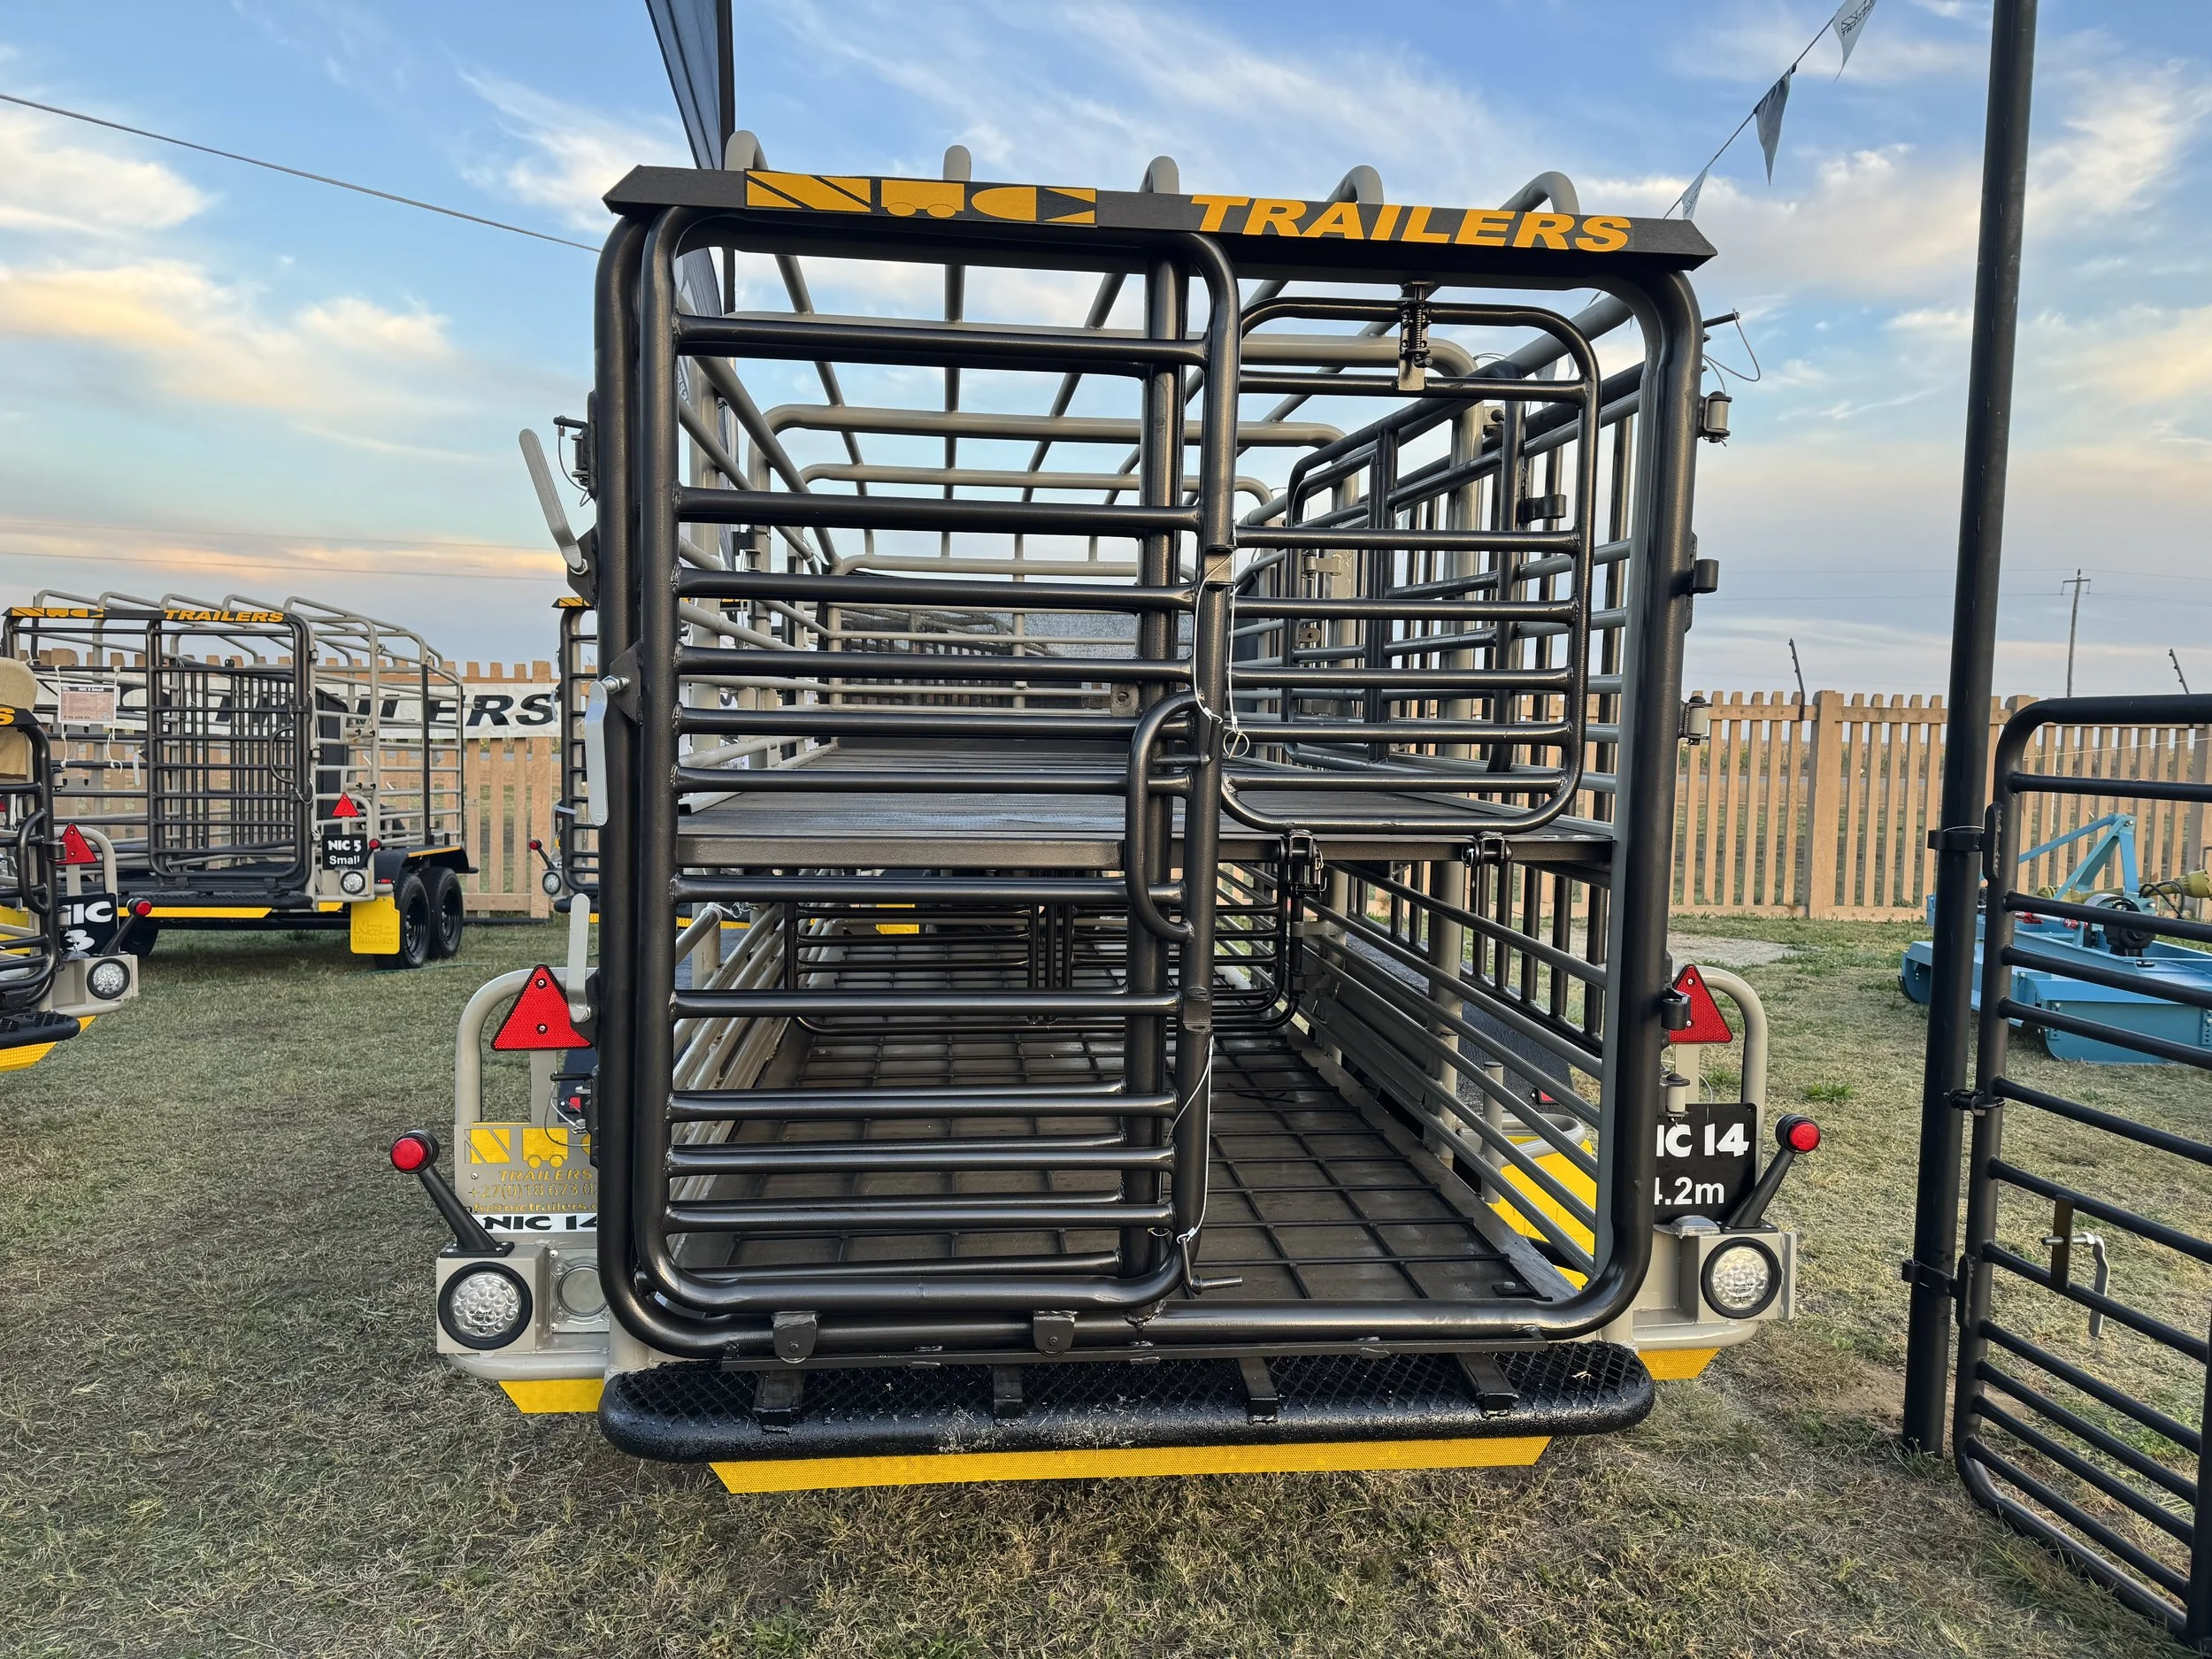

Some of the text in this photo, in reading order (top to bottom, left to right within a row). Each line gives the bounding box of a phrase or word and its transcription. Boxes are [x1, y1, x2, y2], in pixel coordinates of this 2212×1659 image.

[1191, 194, 1632, 252] TRAILERS
[164, 609, 284, 623] TRAILERS
[327, 840, 362, 852] NIC 5
[329, 855, 360, 865] Small
[1656, 1123, 1749, 1157] IC 14
[500, 1169, 592, 1182] TRAILERS
[548, 1182, 578, 1196] 673
[582, 1182, 597, 1195] 0
[483, 1216, 552, 1231] NIC
